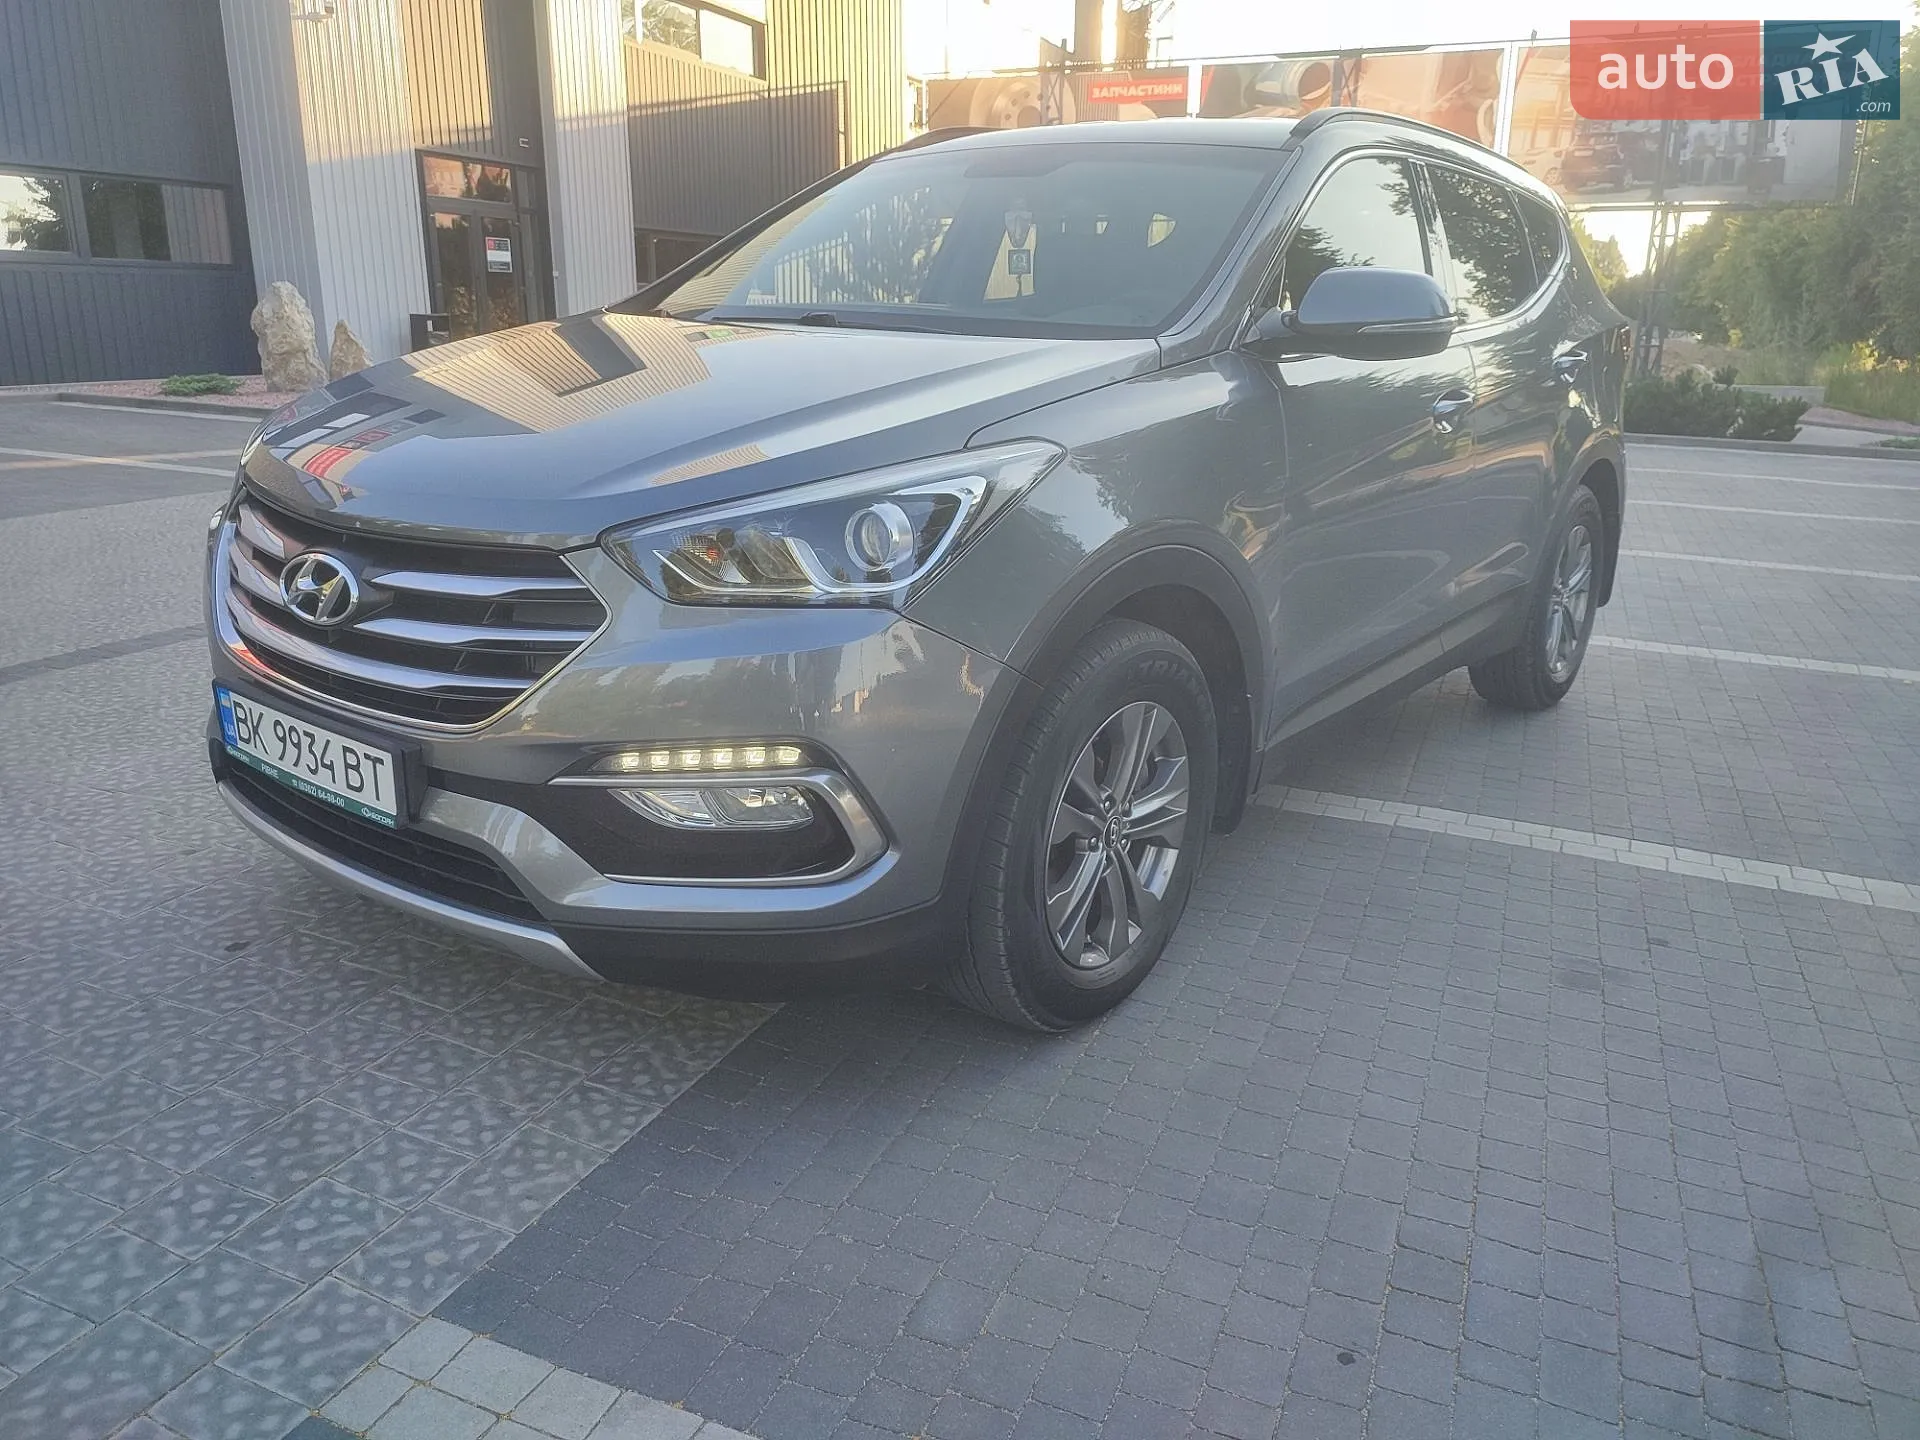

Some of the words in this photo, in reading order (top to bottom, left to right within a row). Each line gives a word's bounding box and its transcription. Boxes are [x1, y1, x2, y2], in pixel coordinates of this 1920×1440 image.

[1092, 83, 1183, 98] ЗАПЧАСТИНИ
[233, 699, 270, 755] BK
[273, 719, 337, 784] 9934
[342, 744, 385, 802] BT
